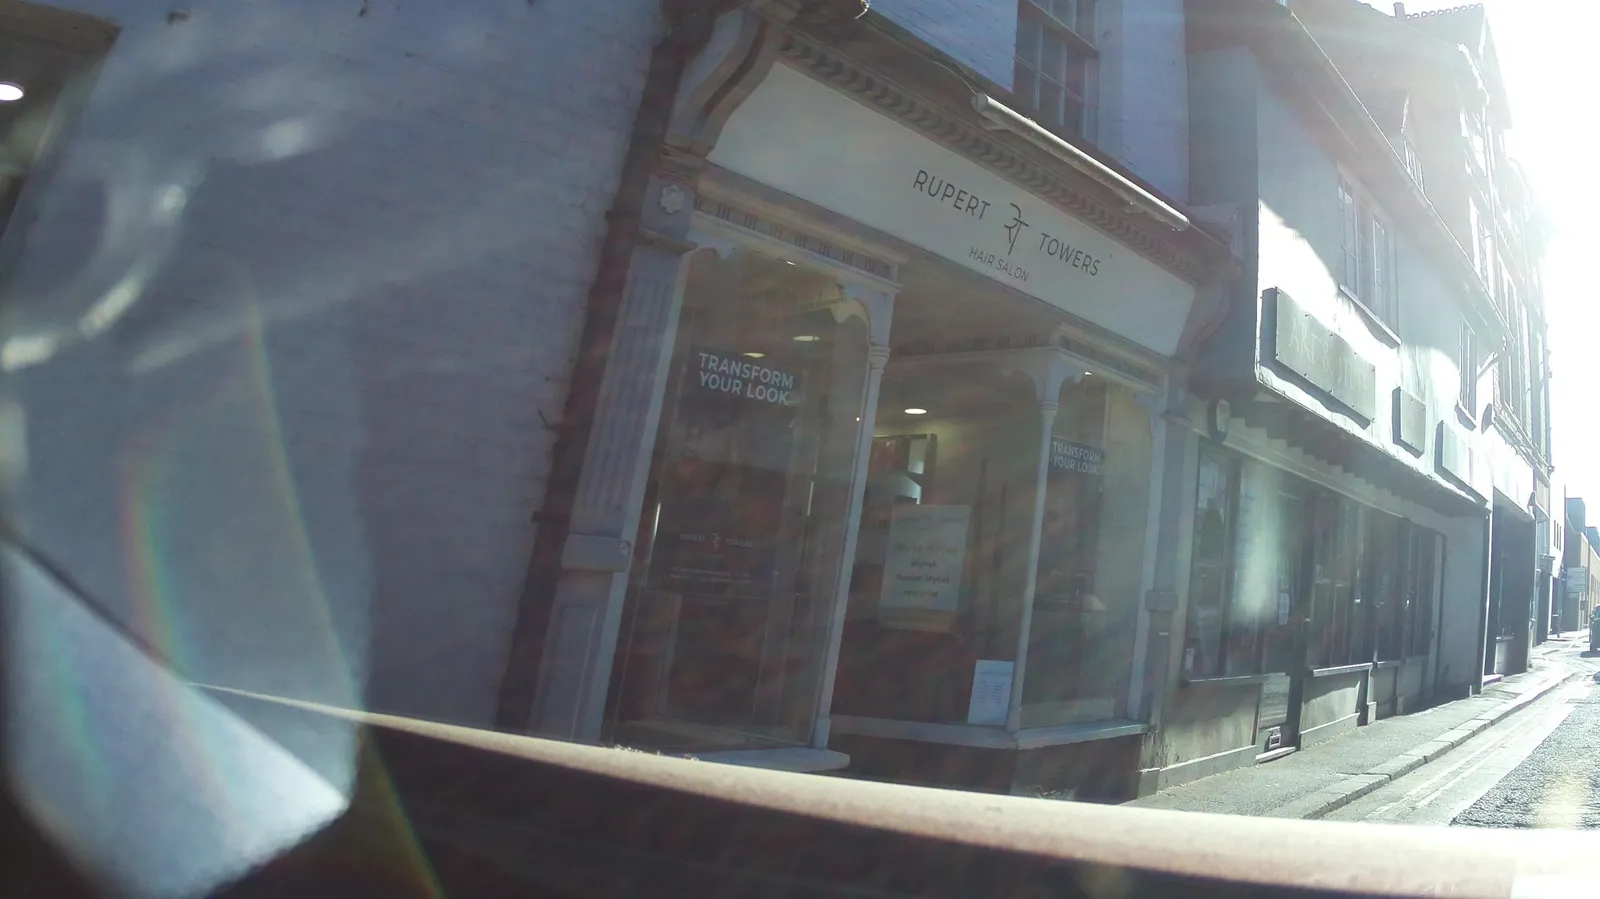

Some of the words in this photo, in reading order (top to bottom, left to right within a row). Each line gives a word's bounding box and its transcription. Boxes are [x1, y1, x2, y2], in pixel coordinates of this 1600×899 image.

[912, 169, 991, 220] RUPERT
[1039, 232, 1101, 277] TOWERS
[968, 246, 996, 267] HAIR
[995, 258, 1030, 283] SALON
[699, 352, 794, 389] TRANSFORM
[700, 371, 742, 395] YOUR
[746, 382, 791, 407] LOOK
[1052, 441, 1101, 462] TRANSFORM
[1053, 454, 1075, 471] YOUR
[1077, 461, 1100, 476] LOOK
